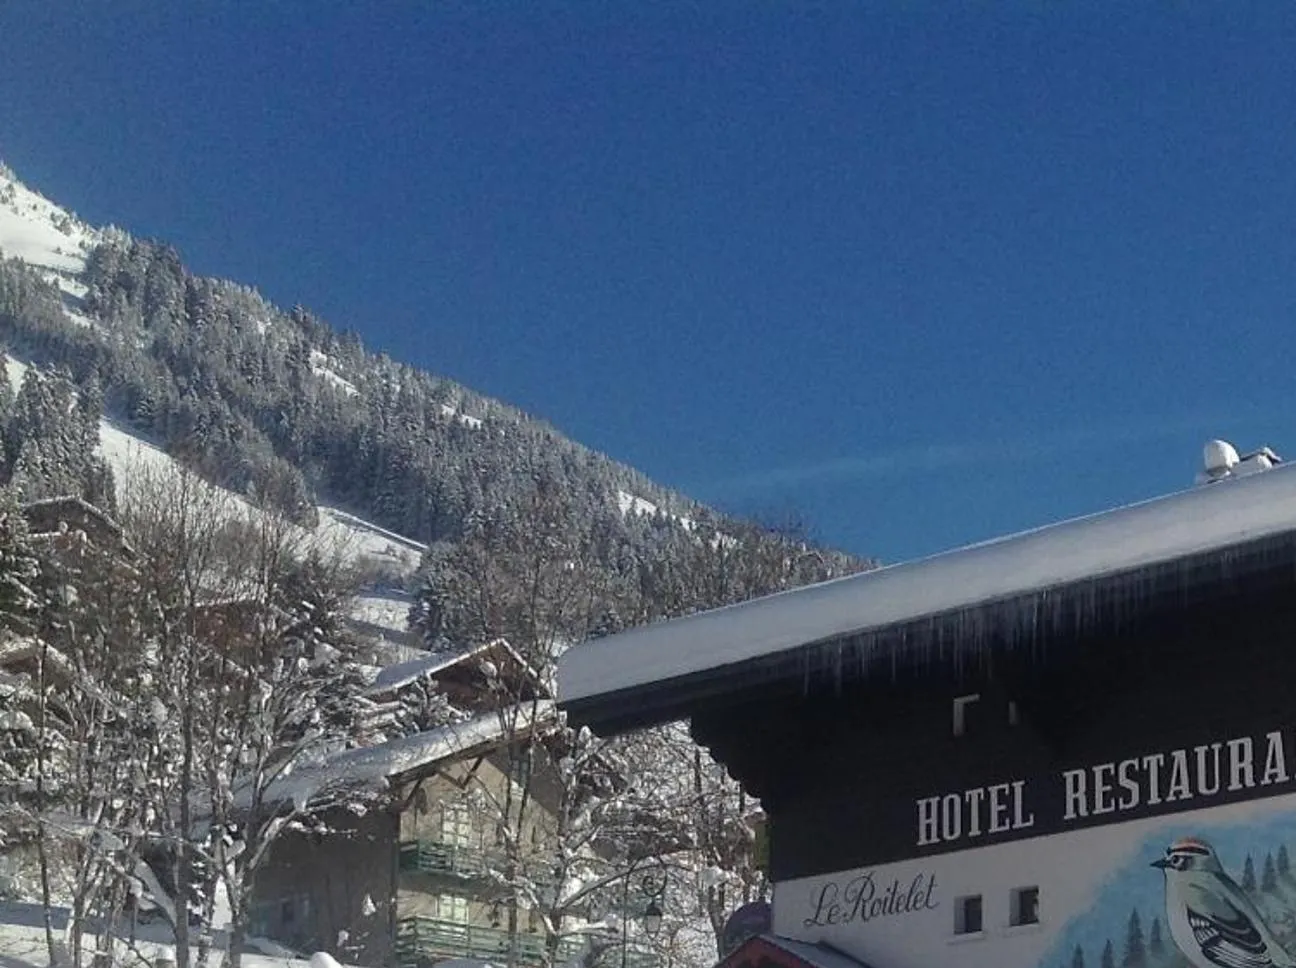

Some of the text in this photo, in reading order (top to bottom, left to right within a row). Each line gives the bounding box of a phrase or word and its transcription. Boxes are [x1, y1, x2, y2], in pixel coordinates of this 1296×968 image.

[916, 780, 1034, 845] HOTEL
[803, 871, 940, 927] Le Roitelet
